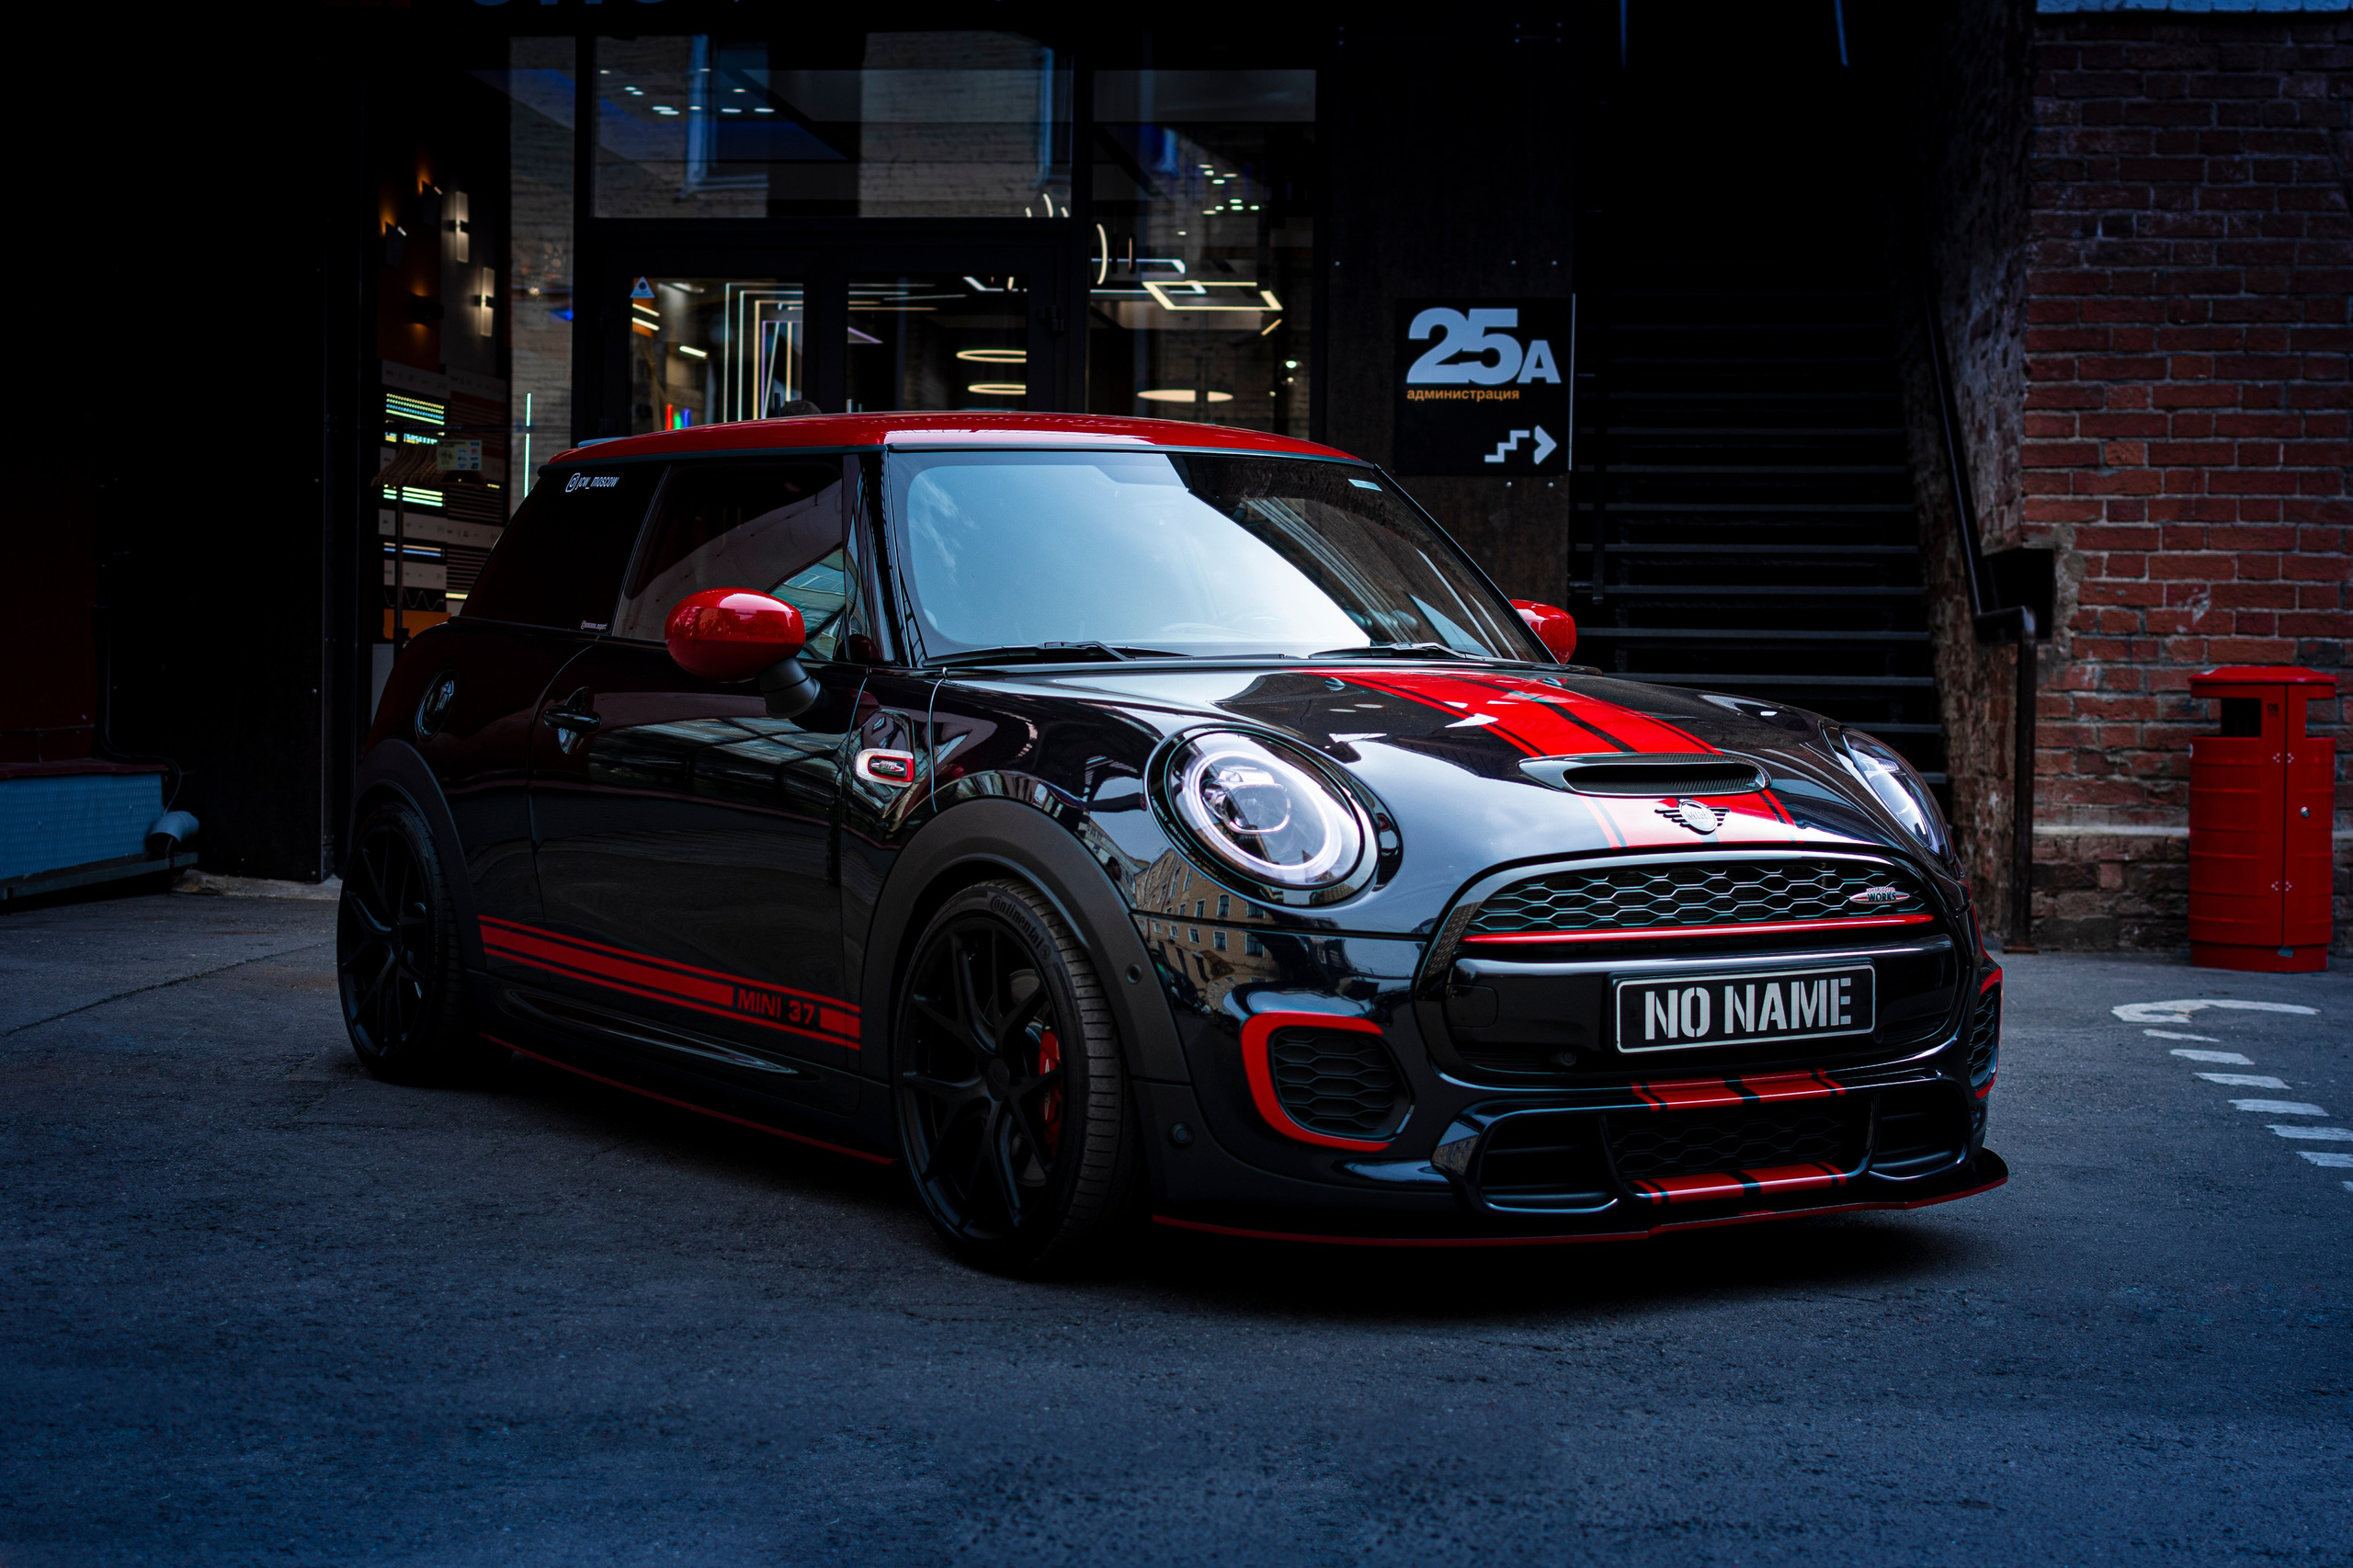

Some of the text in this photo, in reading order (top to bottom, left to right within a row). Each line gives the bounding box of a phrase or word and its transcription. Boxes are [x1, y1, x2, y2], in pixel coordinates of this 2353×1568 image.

[1406, 390, 1520, 403] администрация
[1868, 892, 1896, 903] WORKS
[990, 895, 1044, 949] Continental
[737, 987, 815, 1025] MINI 37
[1644, 977, 1852, 1040] NO NAME
